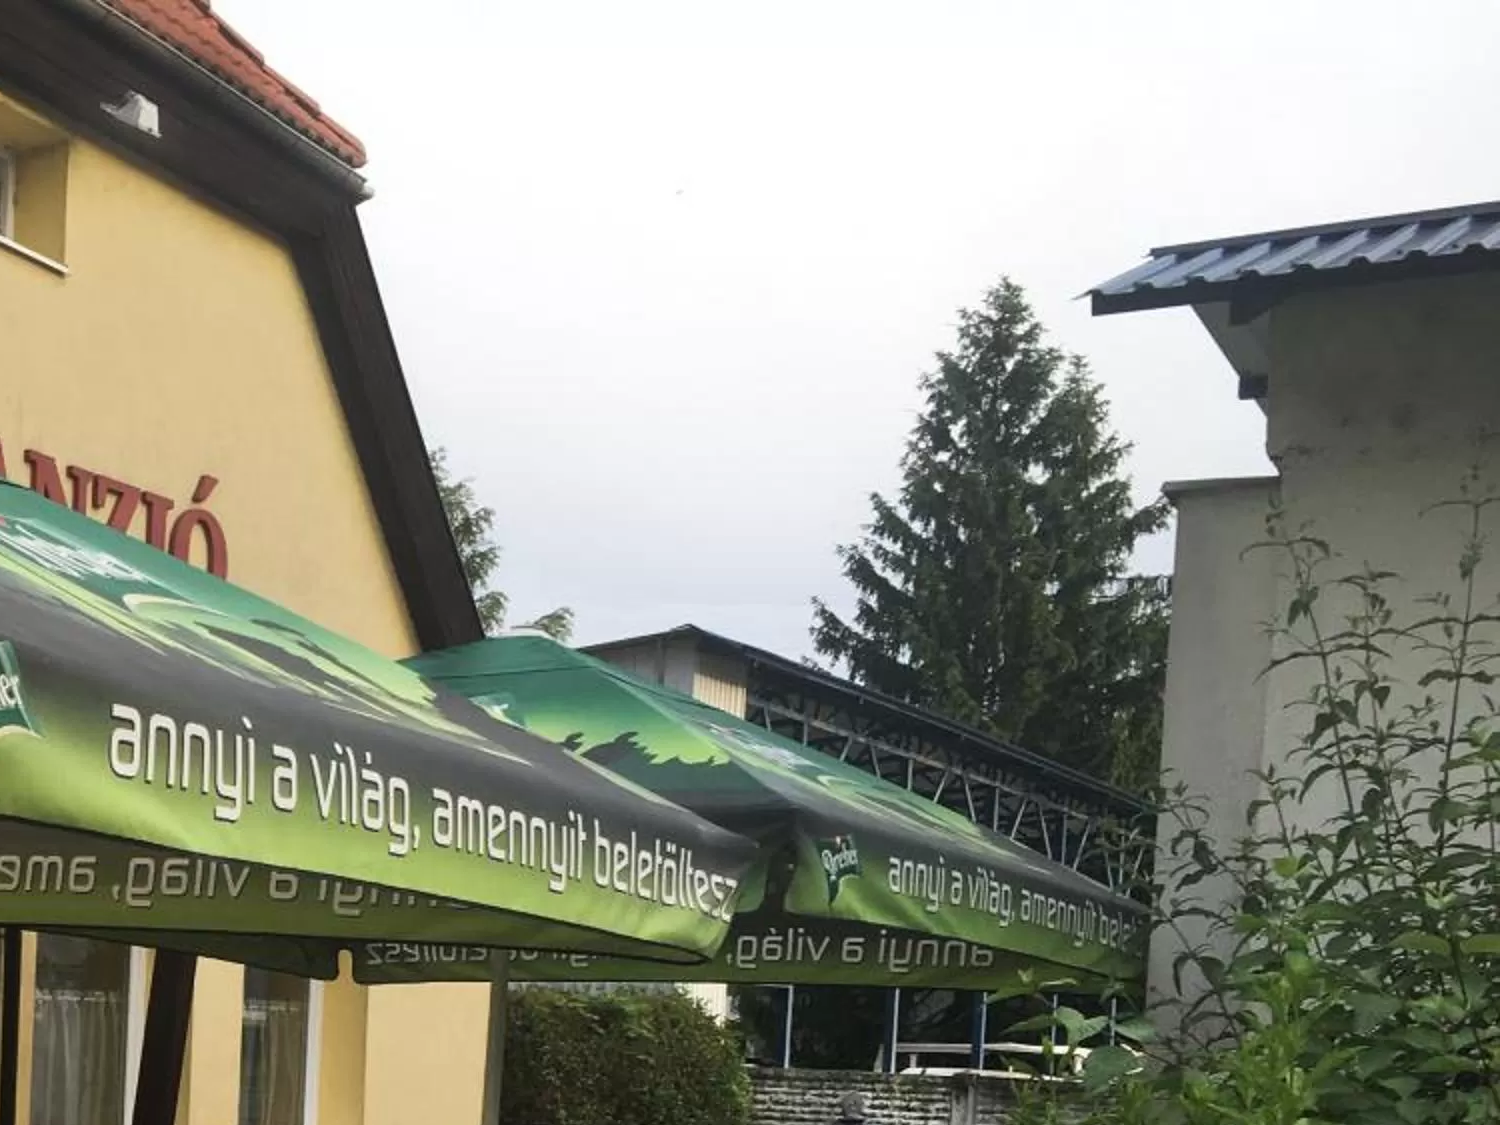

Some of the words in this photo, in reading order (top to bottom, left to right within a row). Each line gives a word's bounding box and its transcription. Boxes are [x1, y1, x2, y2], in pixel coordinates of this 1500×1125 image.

[110, 703, 256, 822] annyi
[271, 743, 298, 812] a
[310, 741, 422, 856] világ,
[431, 788, 588, 893] amennyit
[593, 818, 739, 923] beletöltesz
[888, 856, 946, 914] annyi
[950, 869, 963, 906] a
